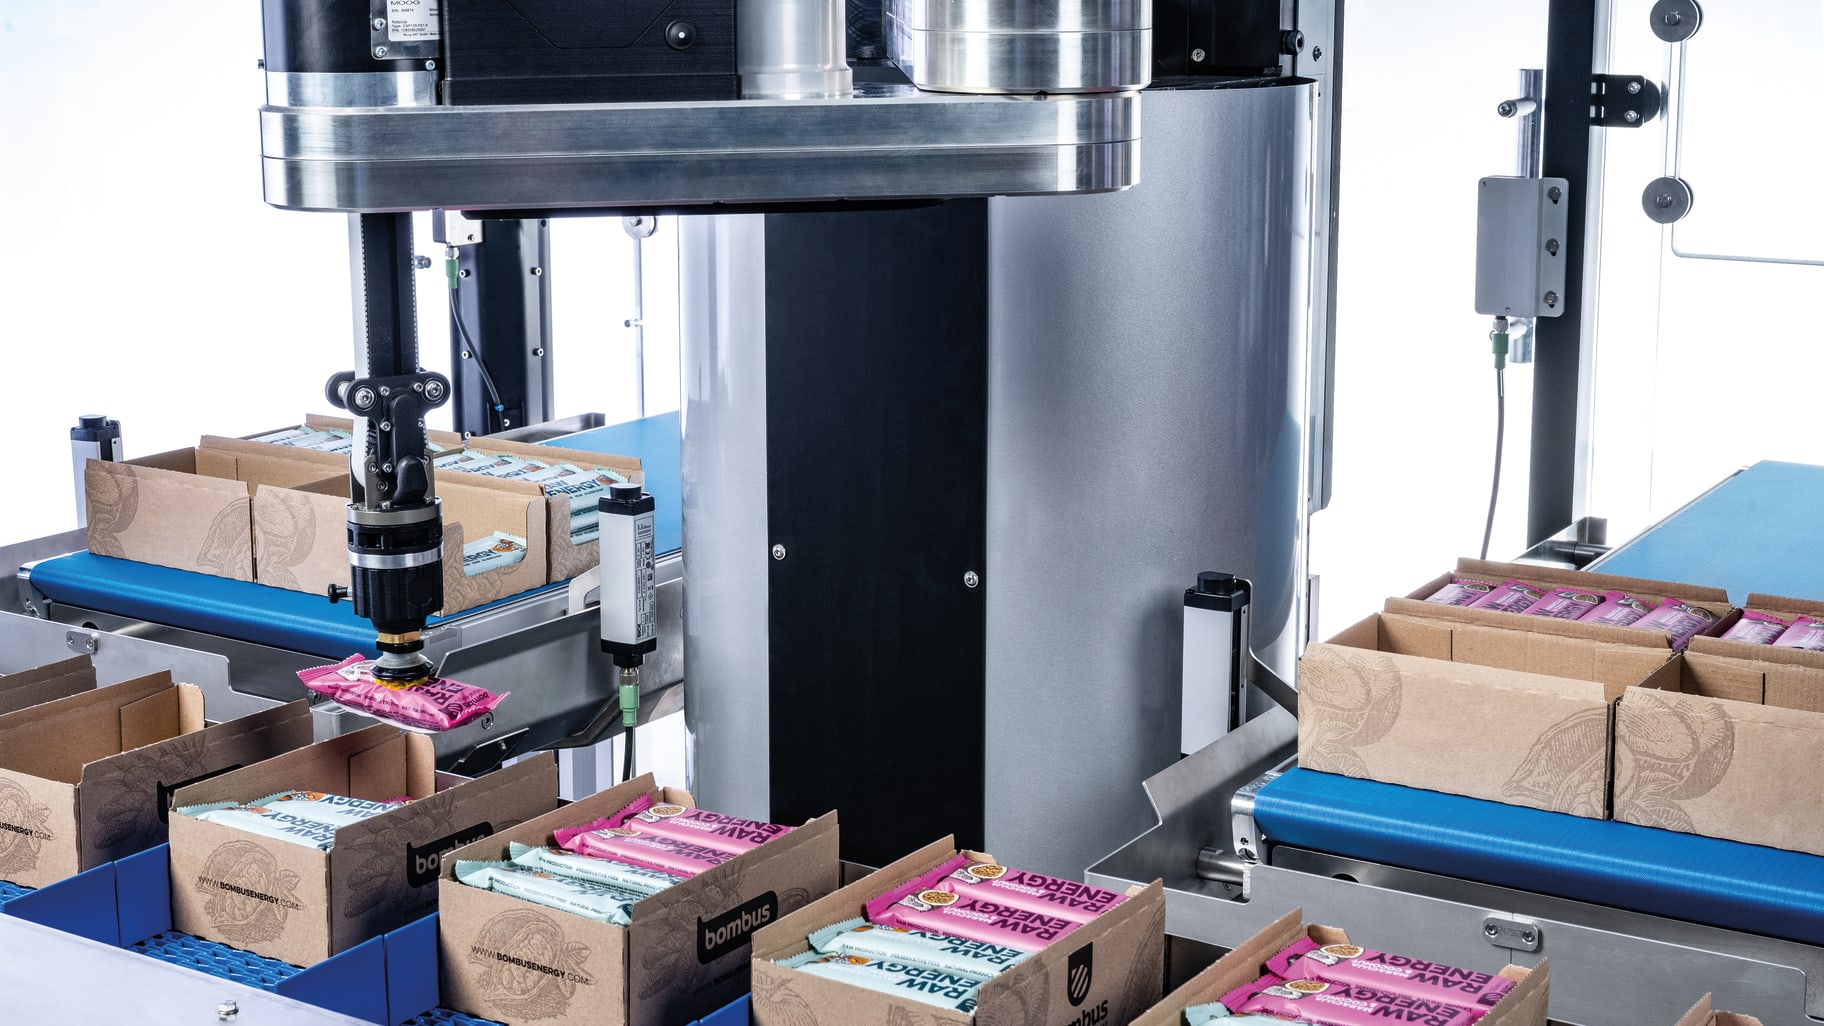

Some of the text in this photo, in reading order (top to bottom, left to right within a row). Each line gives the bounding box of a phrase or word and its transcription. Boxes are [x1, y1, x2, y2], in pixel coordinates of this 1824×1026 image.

[320, 795, 393, 811] NERGY
[336, 808, 379, 818] AW
[0, 821, 51, 841] USENERGY.COM
[261, 811, 335, 833] NERGY
[684, 811, 784, 835] ENERGY
[709, 826, 772, 844] RAW
[198, 875, 299, 910] WWW.BOMBUSENERGY.COM
[1007, 872, 1118, 904] ENERGY
[1038, 893, 1106, 912] RAW
[959, 900, 1072, 930] ENERGY
[705, 904, 771, 950] bombus
[908, 922, 938, 934] PRODUCTION
[990, 918, 1060, 941] RAW
[471, 945, 589, 985] WWW.BOMBUSENERGY.COM
[940, 946, 1010, 964] RAW
[866, 960, 981, 989] ENERGY
[1366, 952, 1494, 985] ENERGY
[896, 978, 968, 1000] RAW
[1406, 972, 1484, 994] RAW
[1333, 988, 1462, 1020] ENERGY
[1372, 1006, 1450, 1026] RAW
